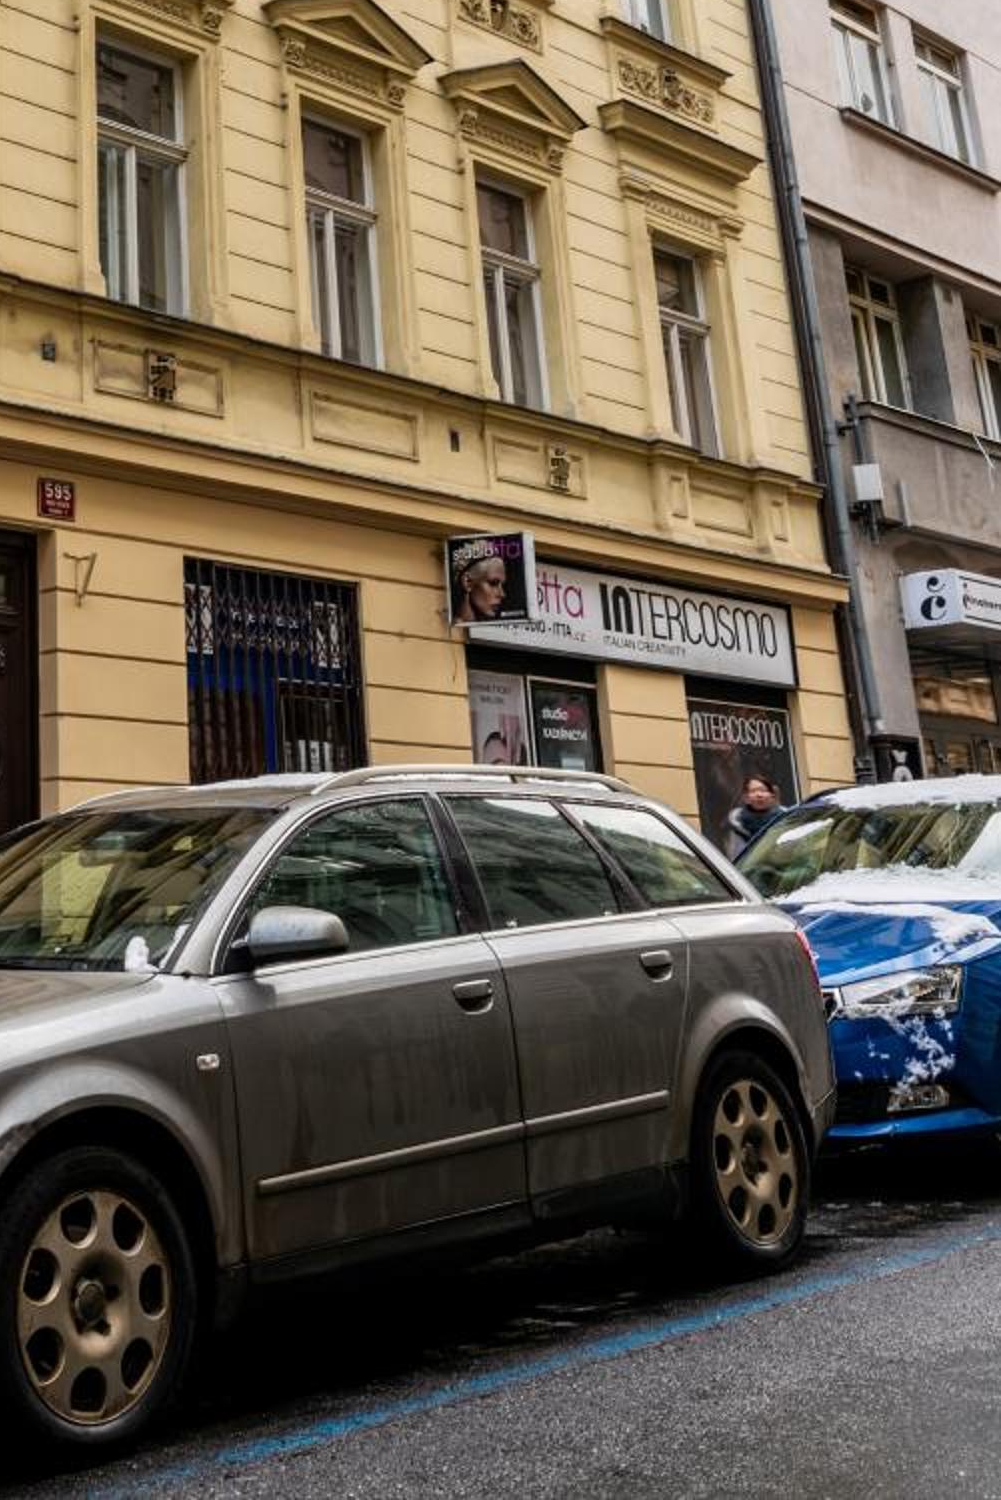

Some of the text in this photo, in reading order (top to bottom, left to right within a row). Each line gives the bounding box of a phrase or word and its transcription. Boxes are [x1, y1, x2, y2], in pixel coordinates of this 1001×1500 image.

[44, 483, 72, 501] 595
[603, 635, 636, 650] ITALIAN
[691, 711, 784, 749] NTERCOSMO
